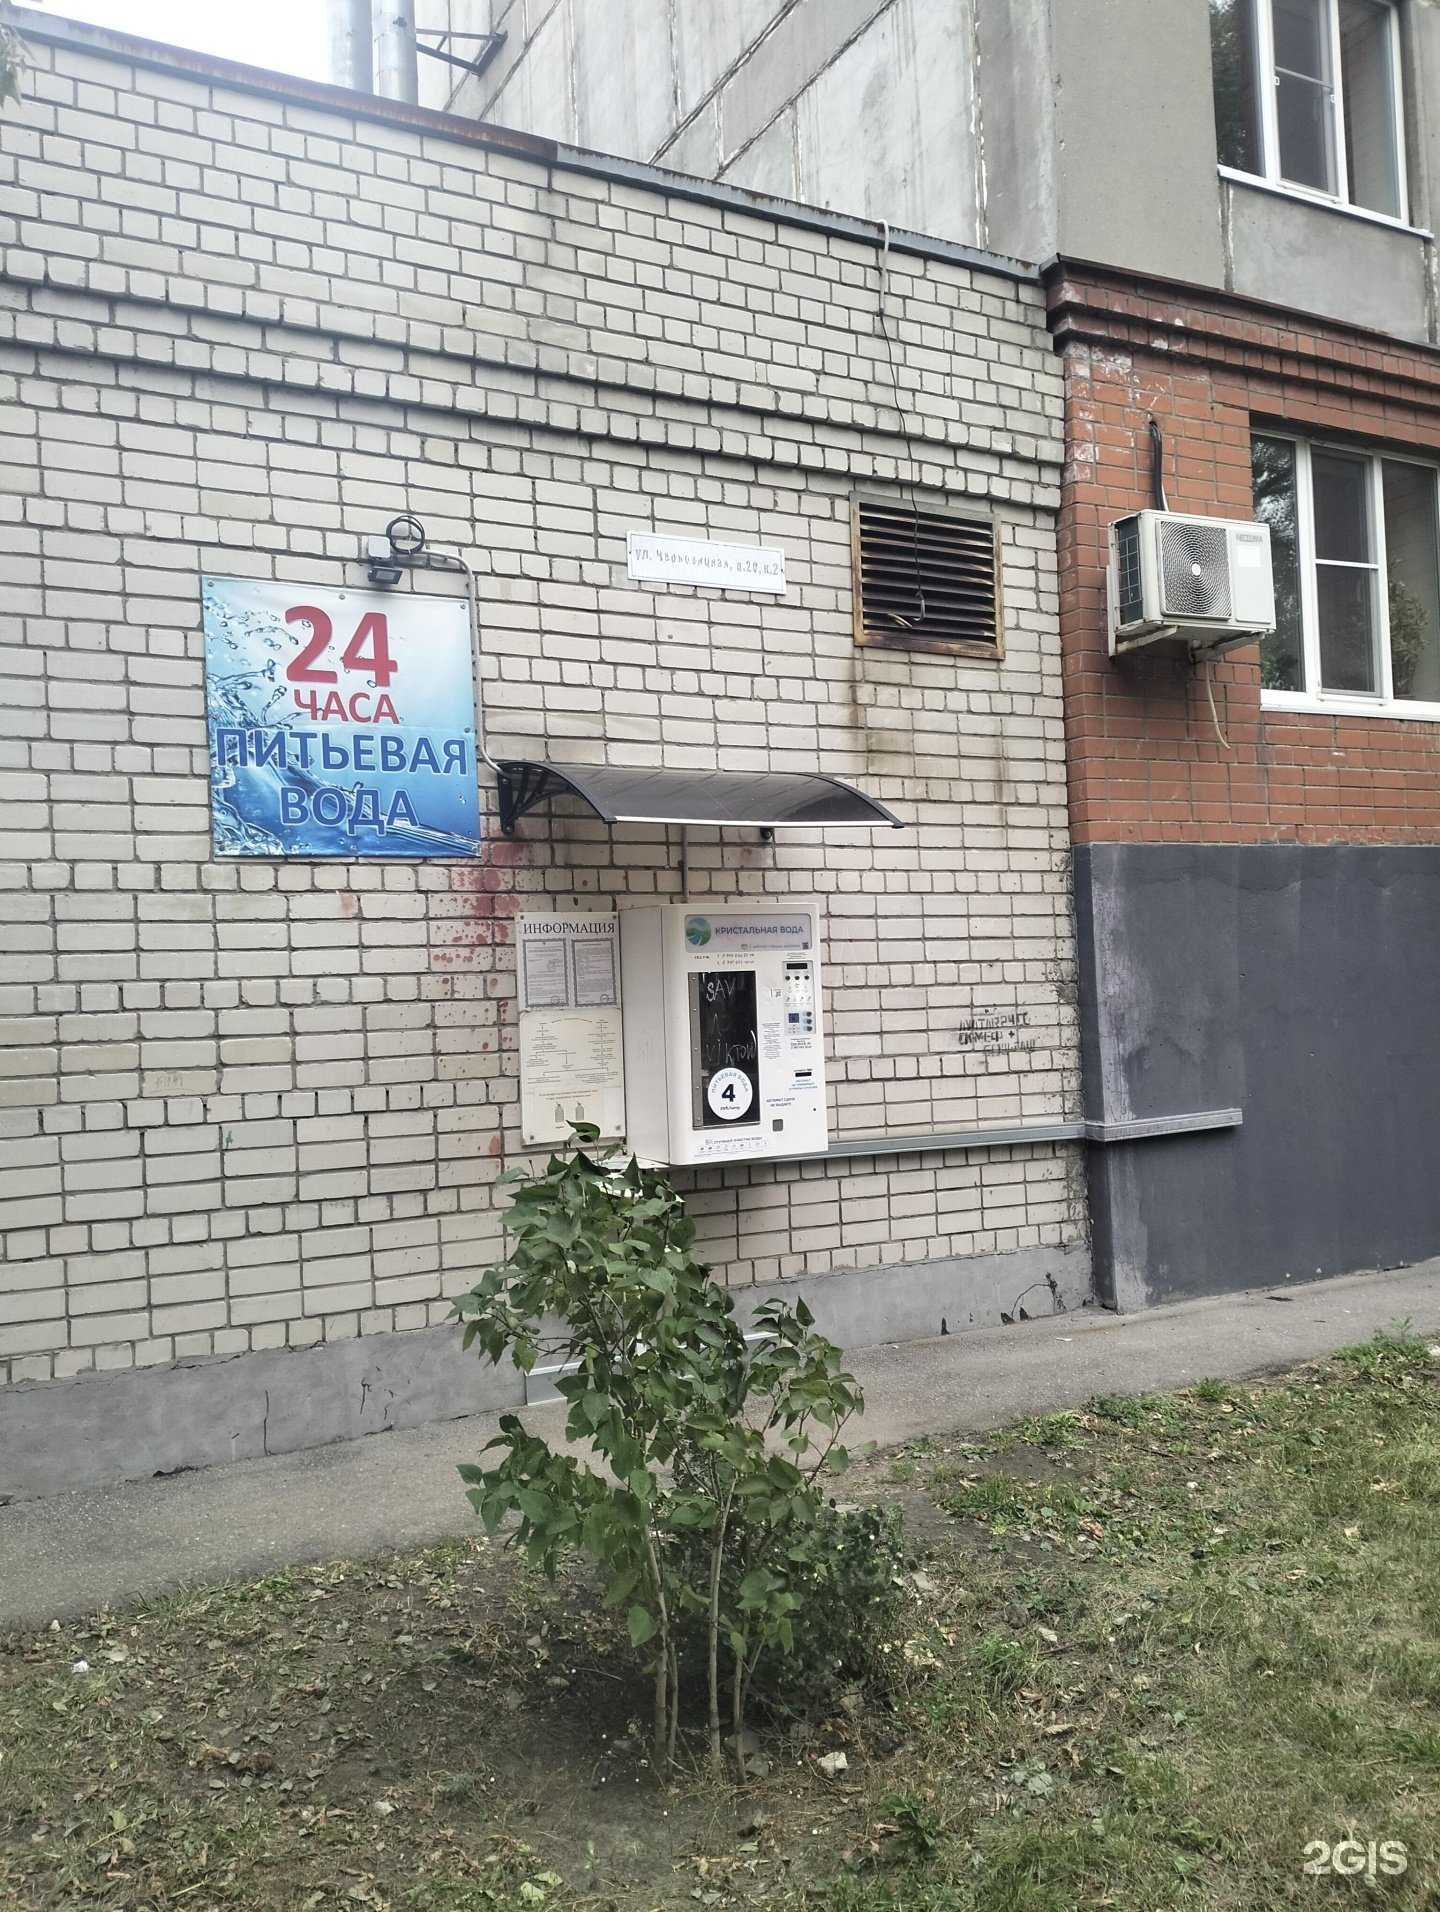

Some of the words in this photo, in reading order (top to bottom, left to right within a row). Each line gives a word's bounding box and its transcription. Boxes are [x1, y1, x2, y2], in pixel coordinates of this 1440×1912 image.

[635, 549, 652, 561] ул.
[284, 604, 398, 688] 24
[293, 689, 401, 725] ЧАСА
[215, 727, 468, 776] ПИТЬЕВАЯ
[279, 785, 420, 837] ВОДА
[523, 922, 616, 936] ИНФОРМАЦИЯ
[715, 925, 778, 936] КРИСТАЛЬНАЯ
[780, 925, 804, 935] ВОДА
[721, 1083, 737, 1103] 4
